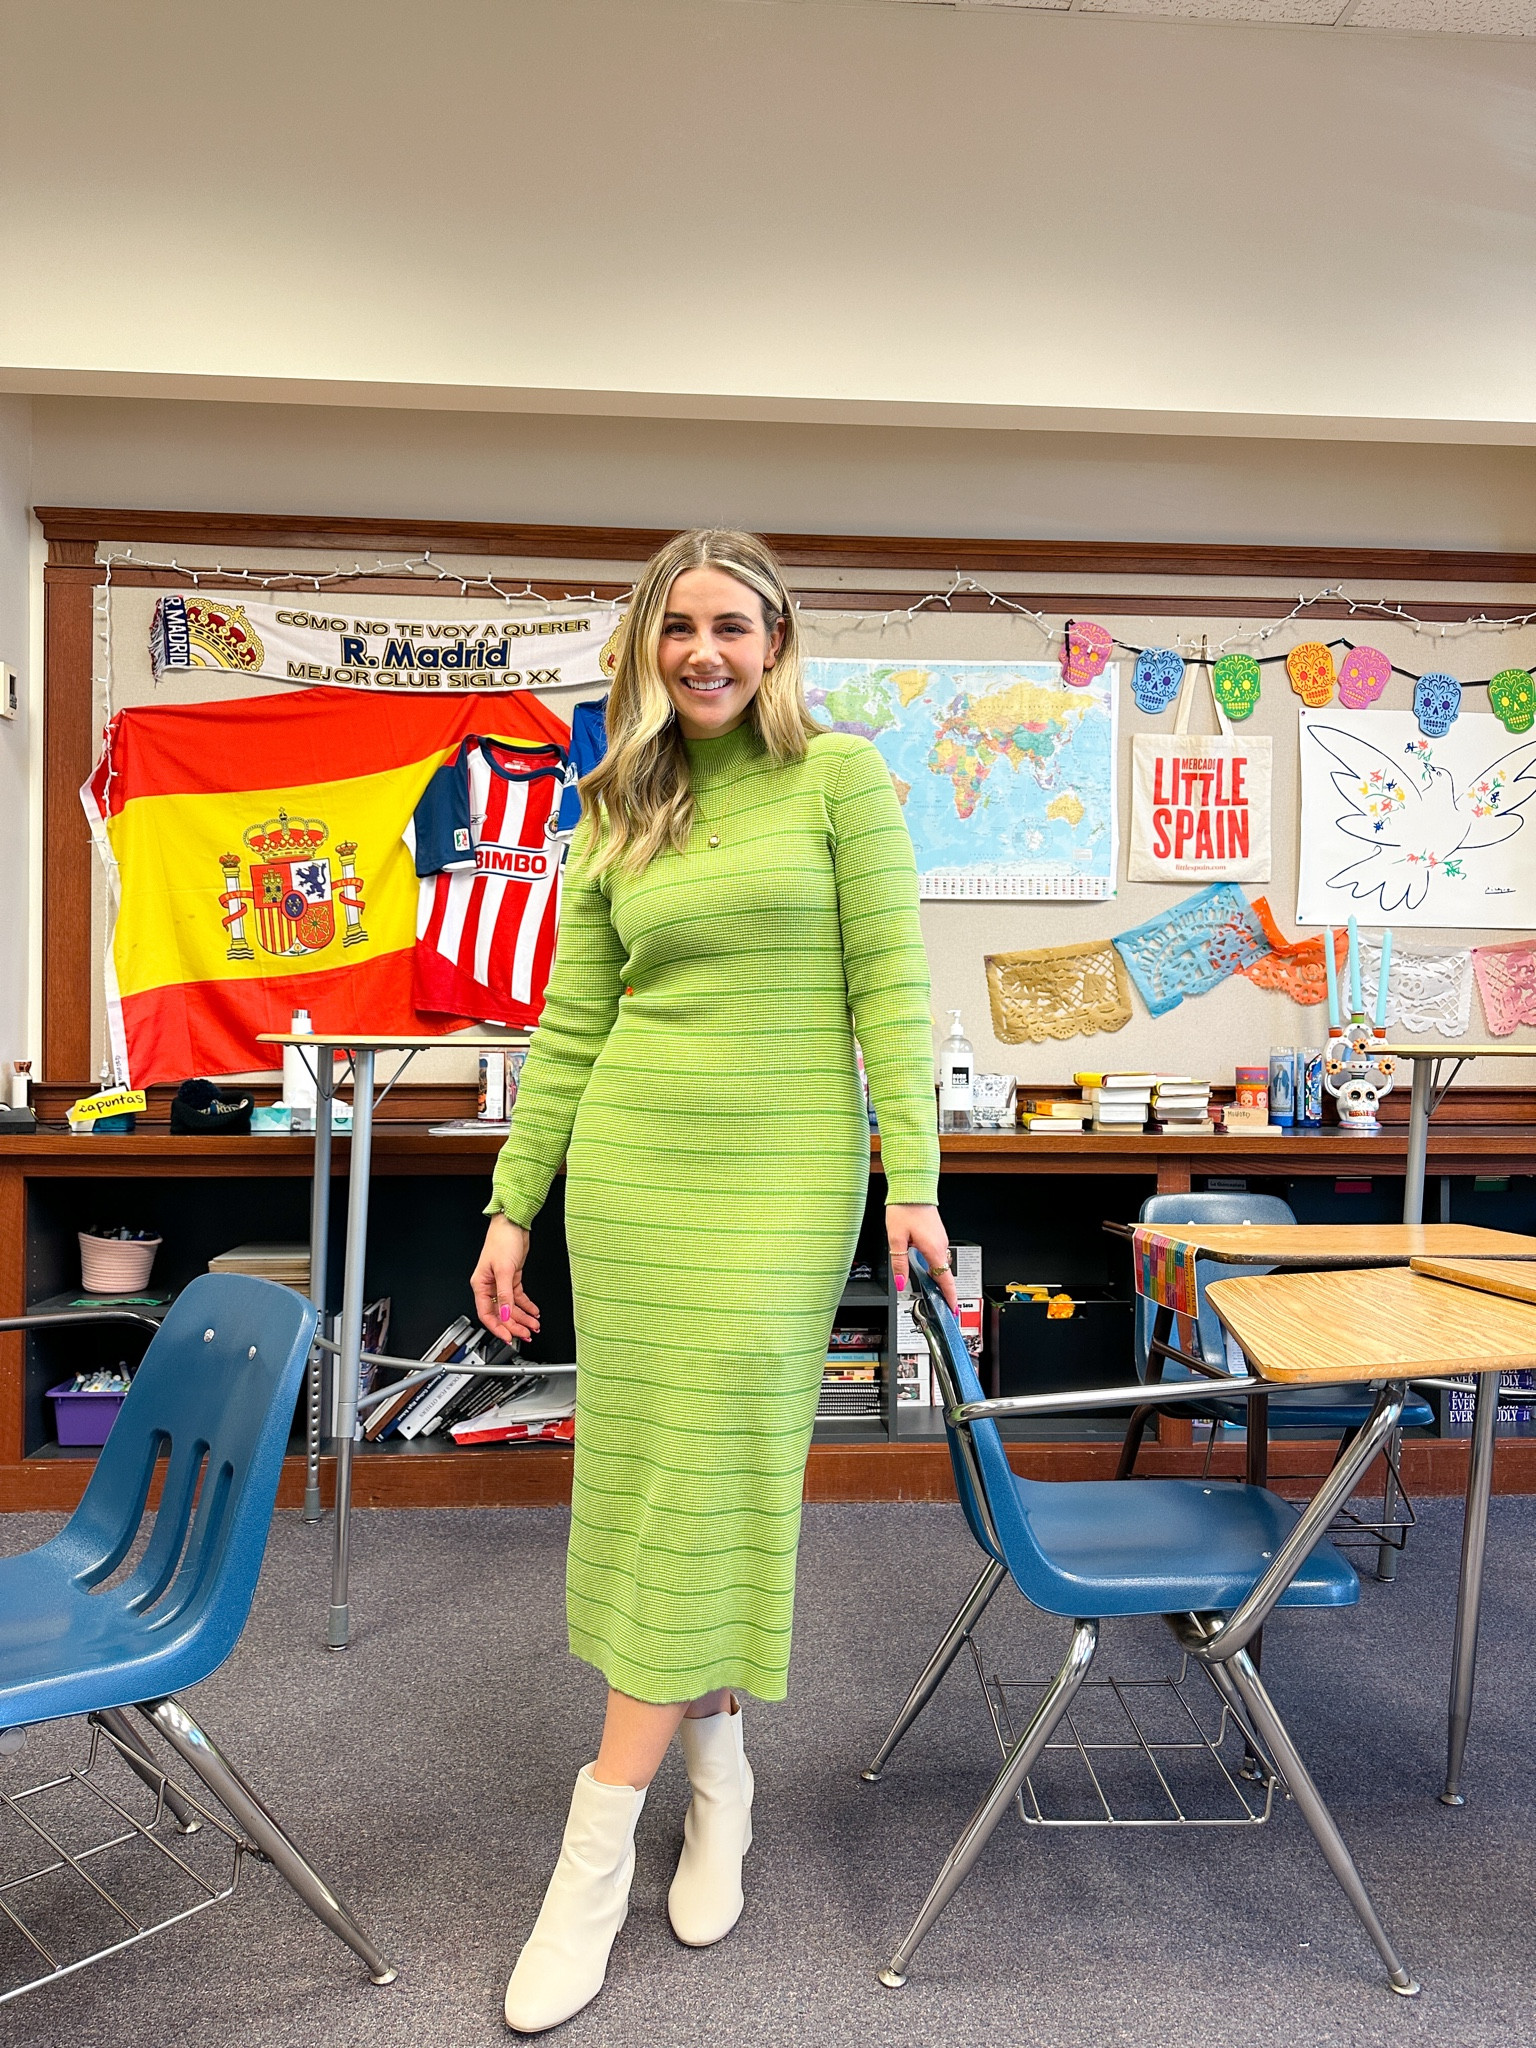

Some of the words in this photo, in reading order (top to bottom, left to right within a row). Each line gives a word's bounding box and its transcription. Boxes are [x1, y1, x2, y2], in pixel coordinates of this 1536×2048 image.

[275, 610, 348, 632] CÓMO
[354, 620, 390, 636] NO
[395, 623, 424, 638] TE
[426, 623, 478, 638] VOY
[482, 624, 499, 638] A
[502, 619, 590, 637] QUERER
[382, 637, 511, 670] Madrid
[287, 661, 371, 686] MEJOR
[374, 671, 442, 688] CLUB
[447, 671, 521, 688] SIGLO
[526, 668, 561, 685] XX
[1153, 757, 1249, 806] LITTLE
[1153, 808, 1250, 860] SPAIN
[475, 850, 547, 874] BIMBO
[419, 1398, 439, 1418] OTHERS
[1449, 1410, 1474, 1422] EVER
[1452, 1399, 1475, 1410] EVER
